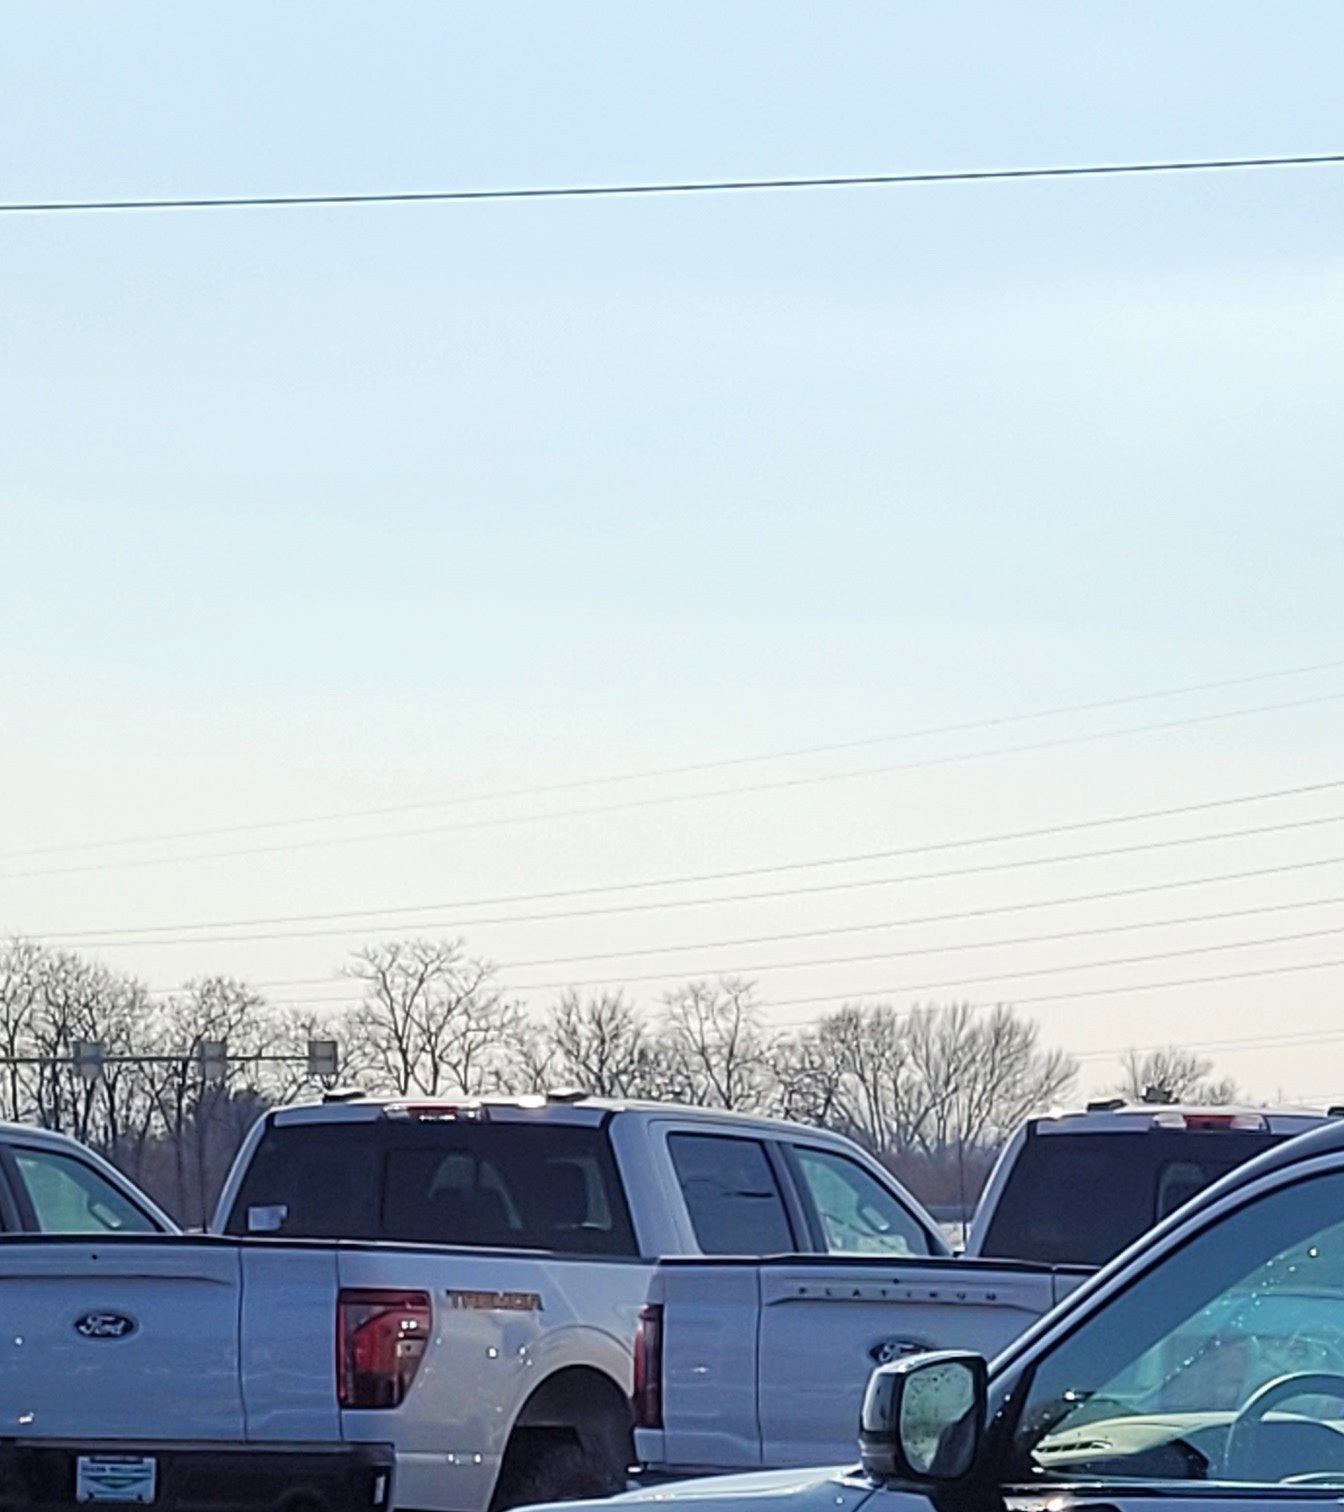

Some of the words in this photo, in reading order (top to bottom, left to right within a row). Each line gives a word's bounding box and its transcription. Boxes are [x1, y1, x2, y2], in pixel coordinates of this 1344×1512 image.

[446, 1289, 544, 1311] TREMOR
[798, 1286, 998, 1302] PLATINUM
[78, 1314, 127, 1336] Ford
